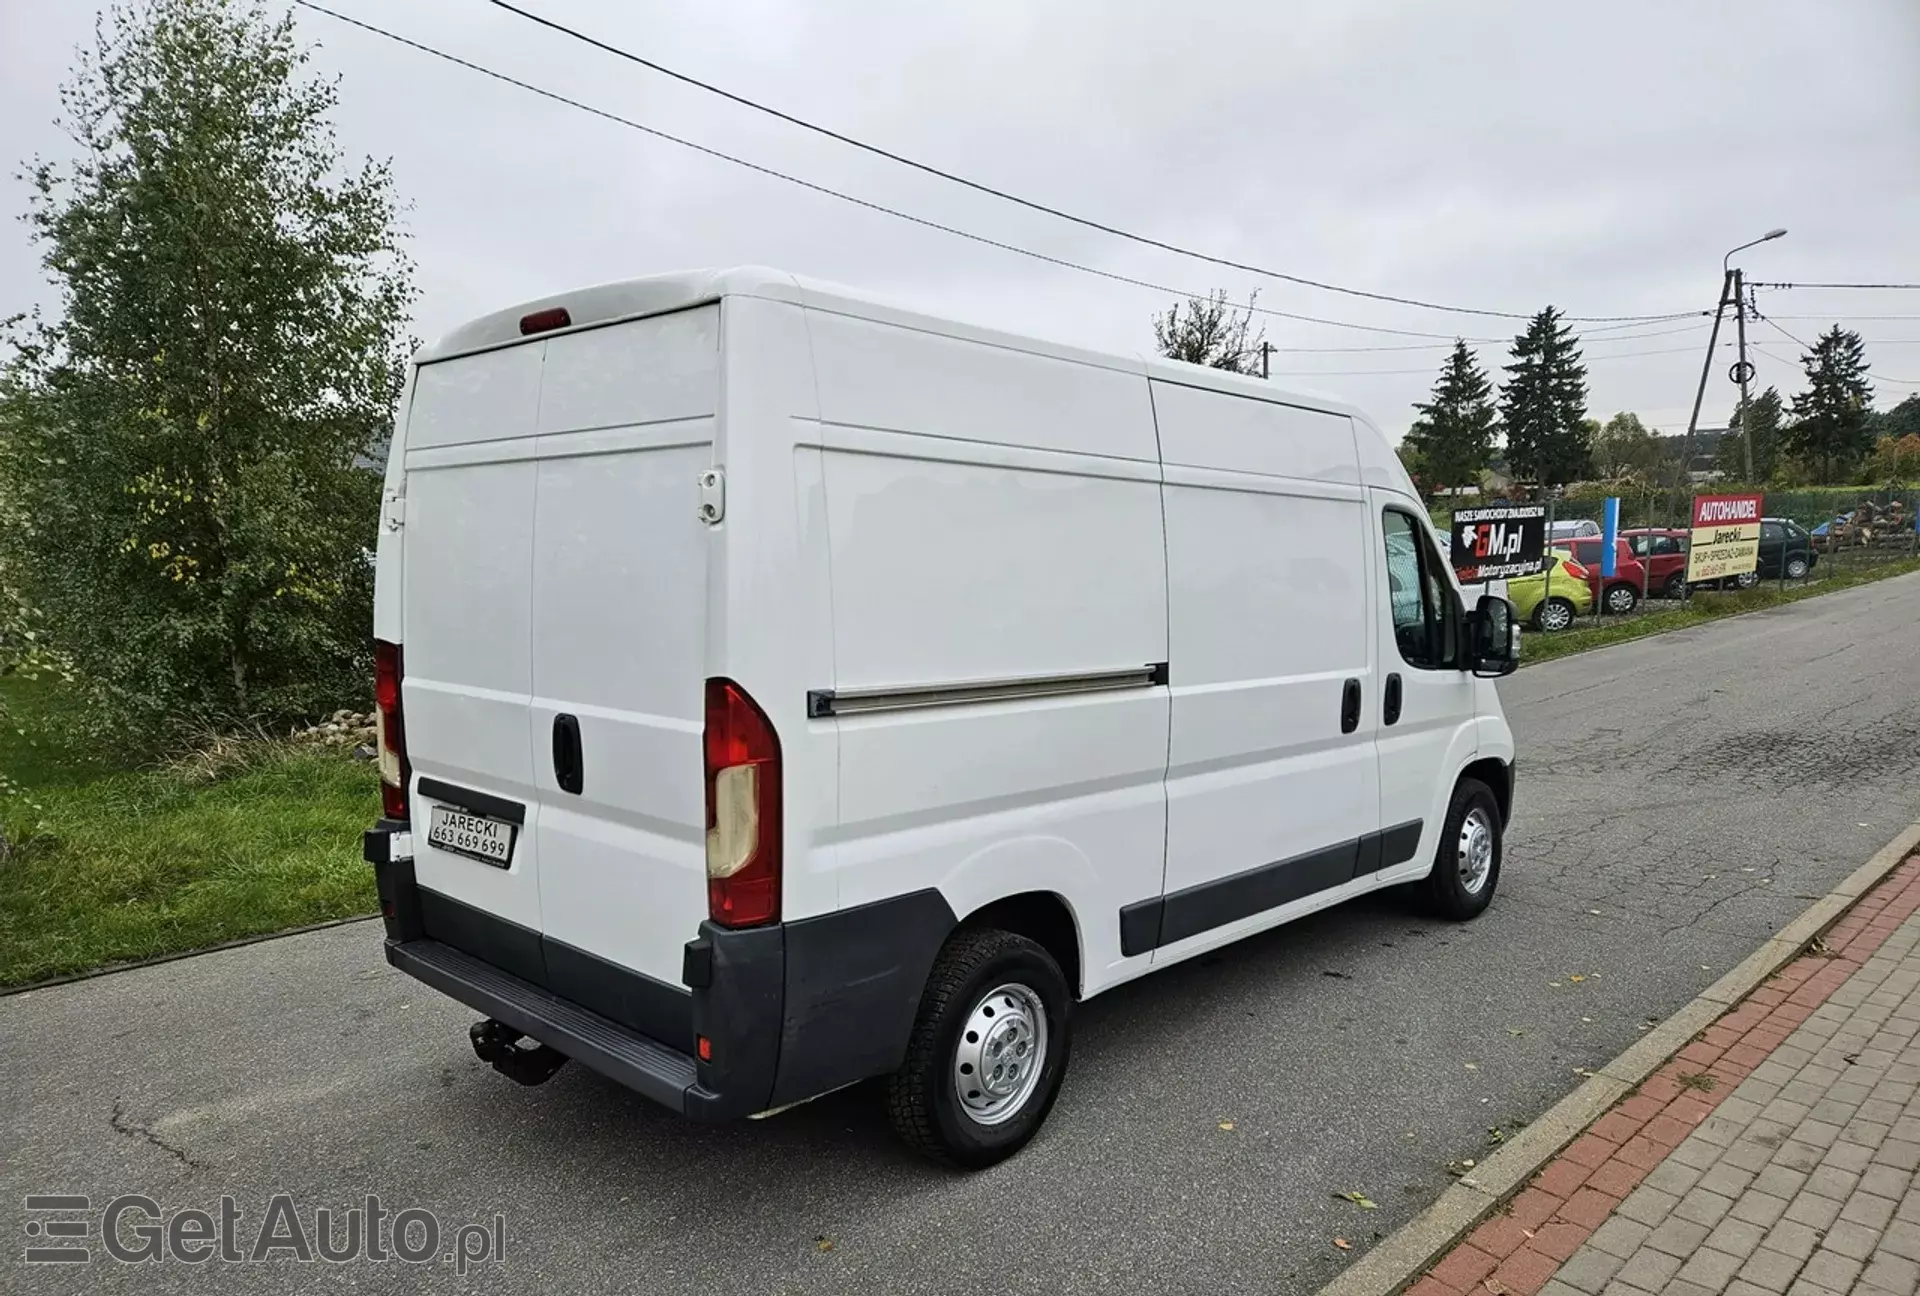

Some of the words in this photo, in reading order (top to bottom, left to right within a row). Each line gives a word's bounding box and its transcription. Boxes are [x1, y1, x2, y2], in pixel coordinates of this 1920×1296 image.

[1699, 500, 1757, 521] AUTOHANDEL
[1475, 523, 1523, 562] GM.pl
[1712, 527, 1742, 545] Jarecki
[442, 812, 498, 838] JARECKI
[433, 826, 454, 843] 663
[457, 832, 478, 849] 669
[481, 838, 506, 856] 699
